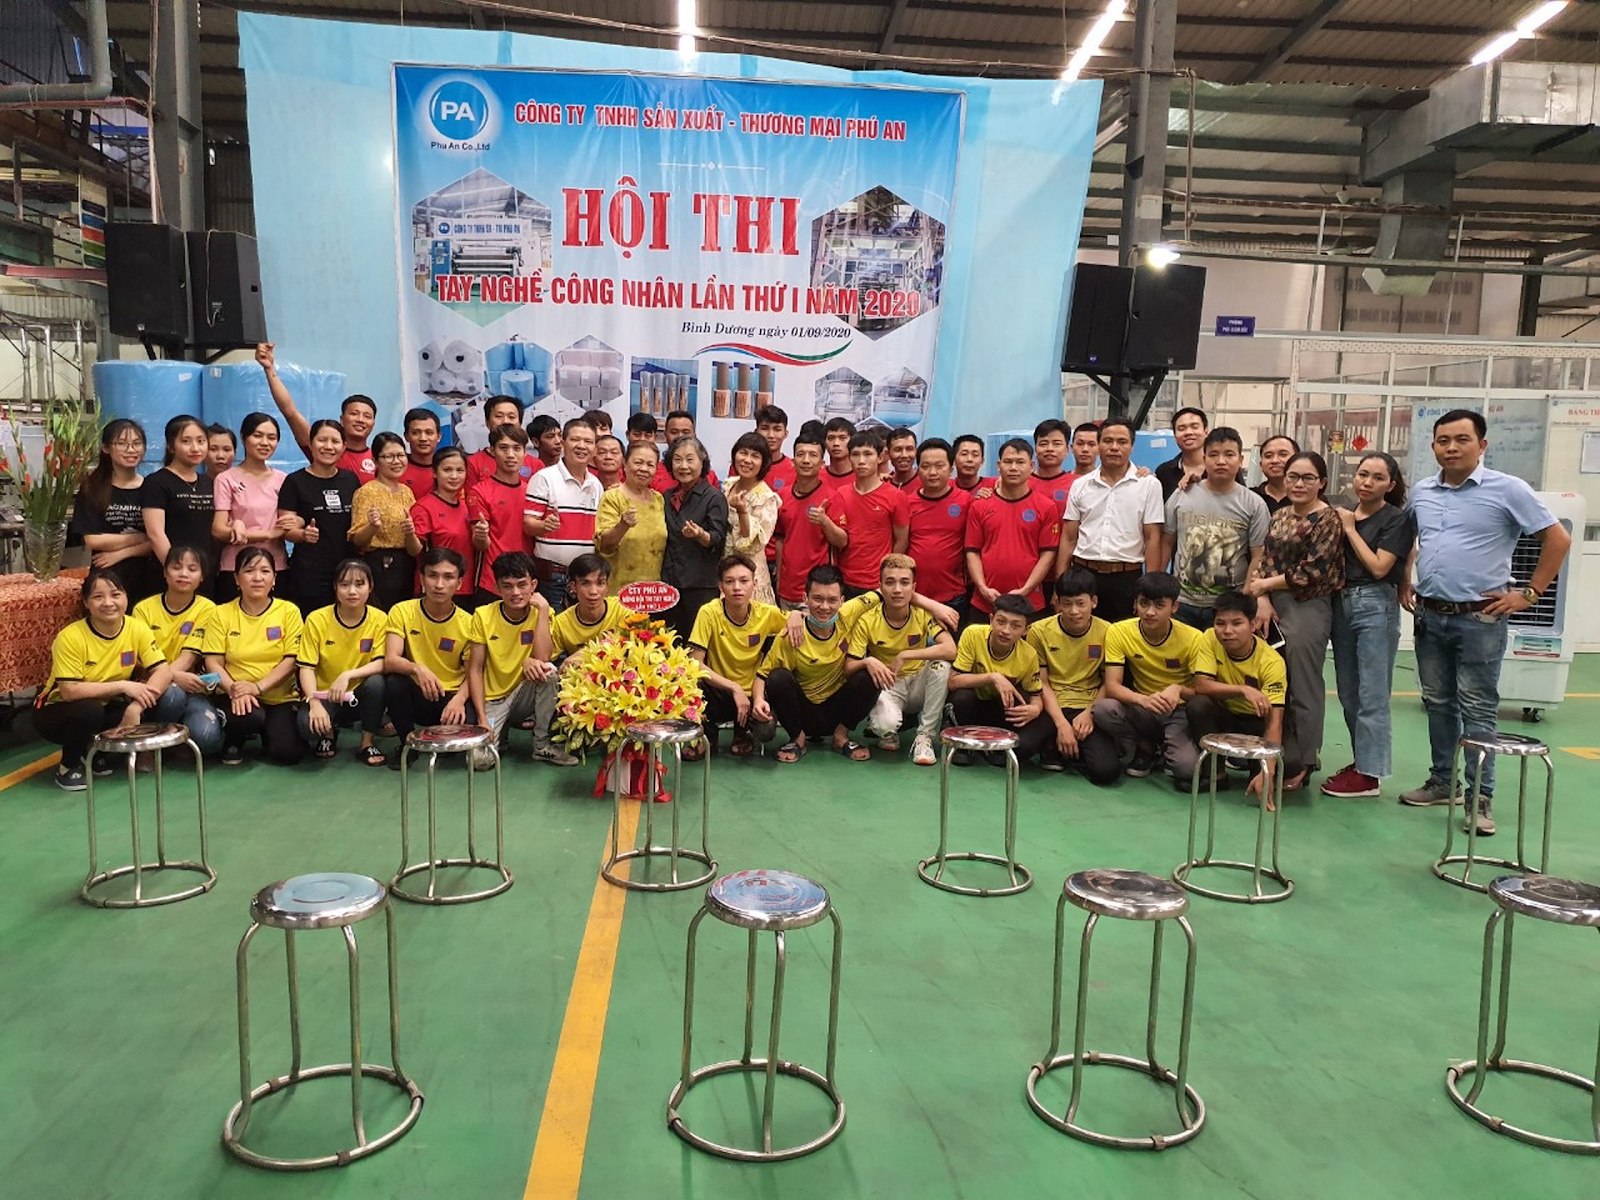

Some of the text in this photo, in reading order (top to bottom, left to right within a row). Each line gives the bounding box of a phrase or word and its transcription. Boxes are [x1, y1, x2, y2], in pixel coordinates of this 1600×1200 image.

[441, 101, 476, 121] PA
[515, 99, 561, 124] CÔNG
[566, 104, 586, 125] TY
[595, 105, 638, 127] TNHH
[643, 102, 677, 129] SẢN
[682, 104, 724, 131] XUẤT
[740, 112, 805, 136] THƯƠNG
[810, 116, 841, 140] MẠI
[846, 115, 879, 139] PHÚ
[882, 121, 906, 141] AN
[431, 141, 447, 150] Phu
[448, 142, 460, 150] An
[562, 175, 801, 259] HỘI THI
[435, 267, 920, 318] TAY NGHỀ CÔNG NHÂN LẦN THỨ I NĂM 2020
[681, 322, 851, 339] Bình Dương ngày 01/09/2020
